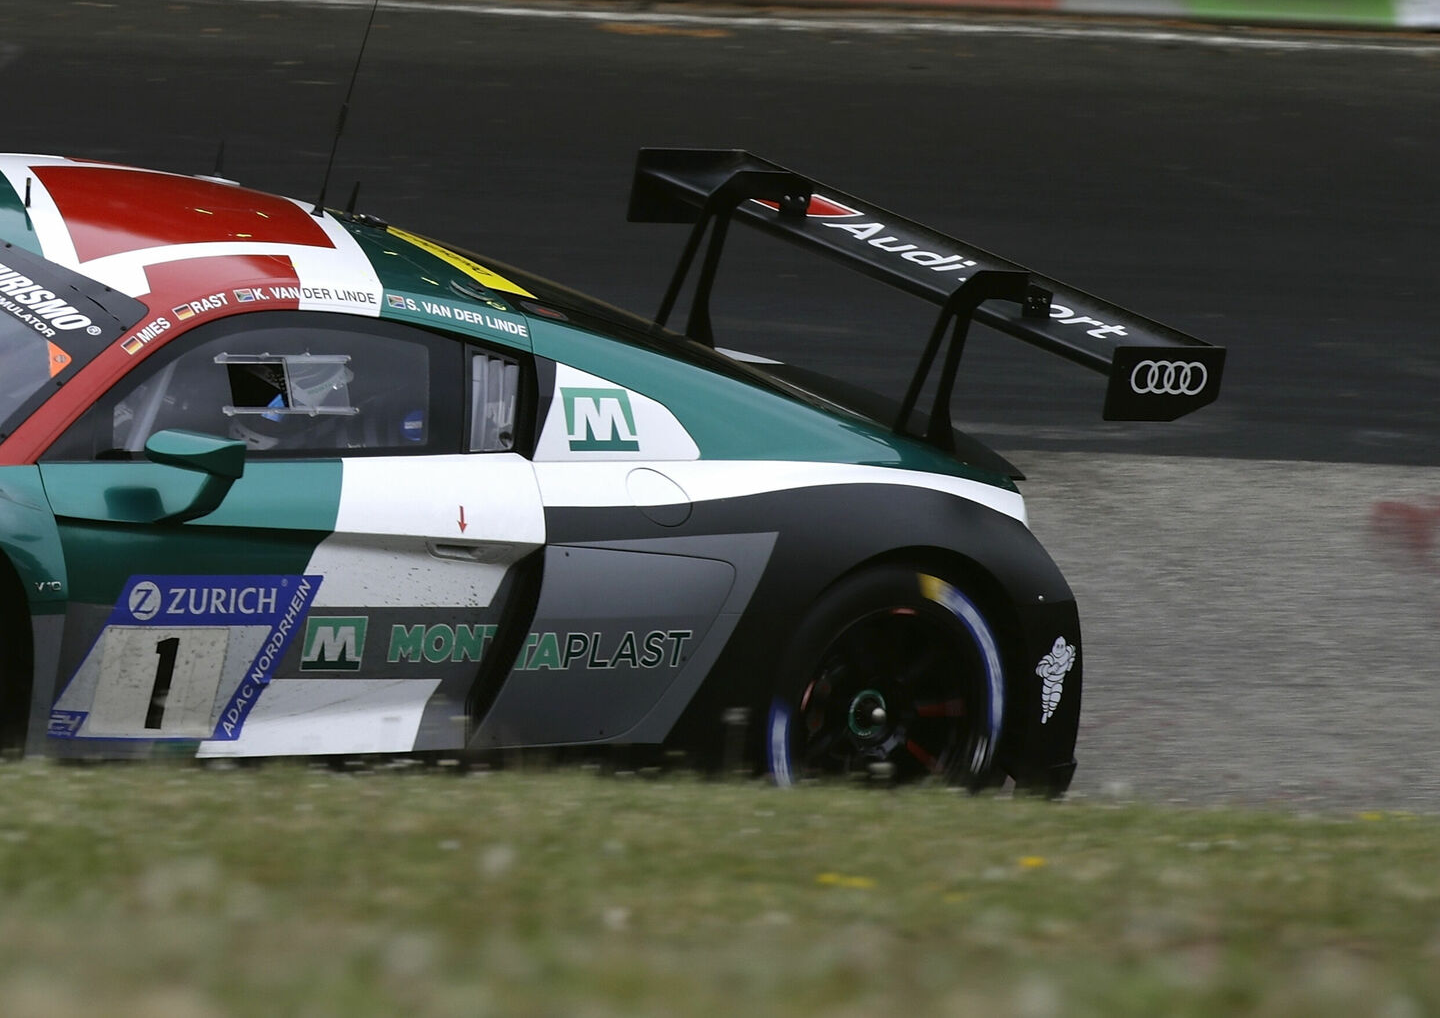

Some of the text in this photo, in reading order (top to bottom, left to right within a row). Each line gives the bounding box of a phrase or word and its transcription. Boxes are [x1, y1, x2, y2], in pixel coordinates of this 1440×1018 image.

[821, 222, 978, 273] Audi
[189, 292, 229, 314] RAST
[251, 286, 377, 305] K. VAN DER LINDE
[136, 317, 172, 343] MIES
[405, 297, 529, 338] S. VAN DER LINDE
[165, 586, 278, 615] ZURICH
[222, 578, 312, 738] ADAC NORDRHEIN
[144, 637, 181, 730] 1
